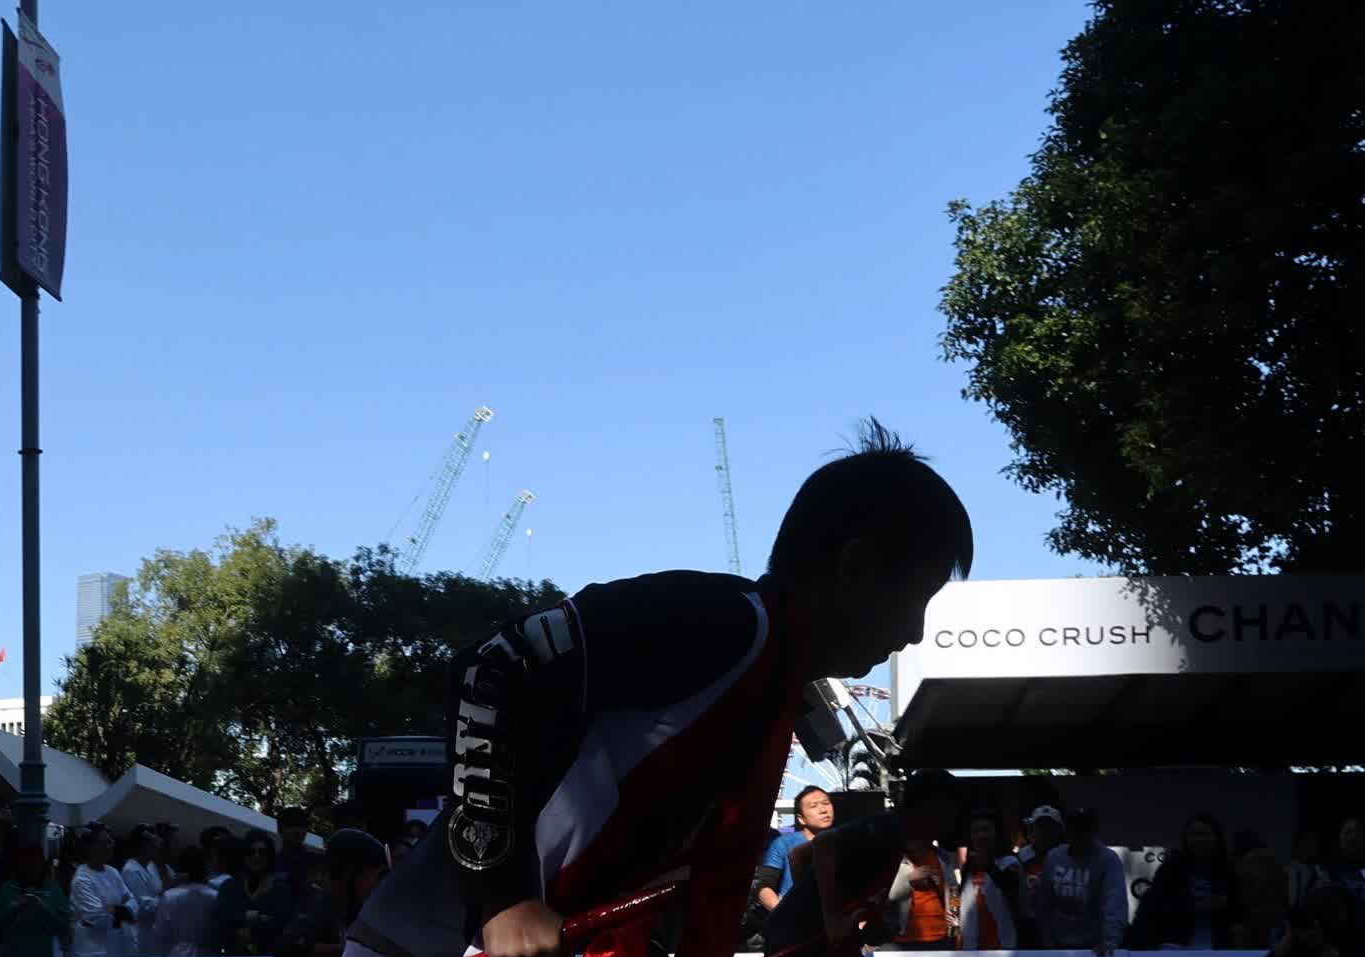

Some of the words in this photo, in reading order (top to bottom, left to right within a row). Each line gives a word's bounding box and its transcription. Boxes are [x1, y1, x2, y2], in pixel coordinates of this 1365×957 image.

[934, 628, 1026, 648] COCO
[1039, 625, 1151, 646] CRUSH
[1189, 604, 1361, 642] CHAN
